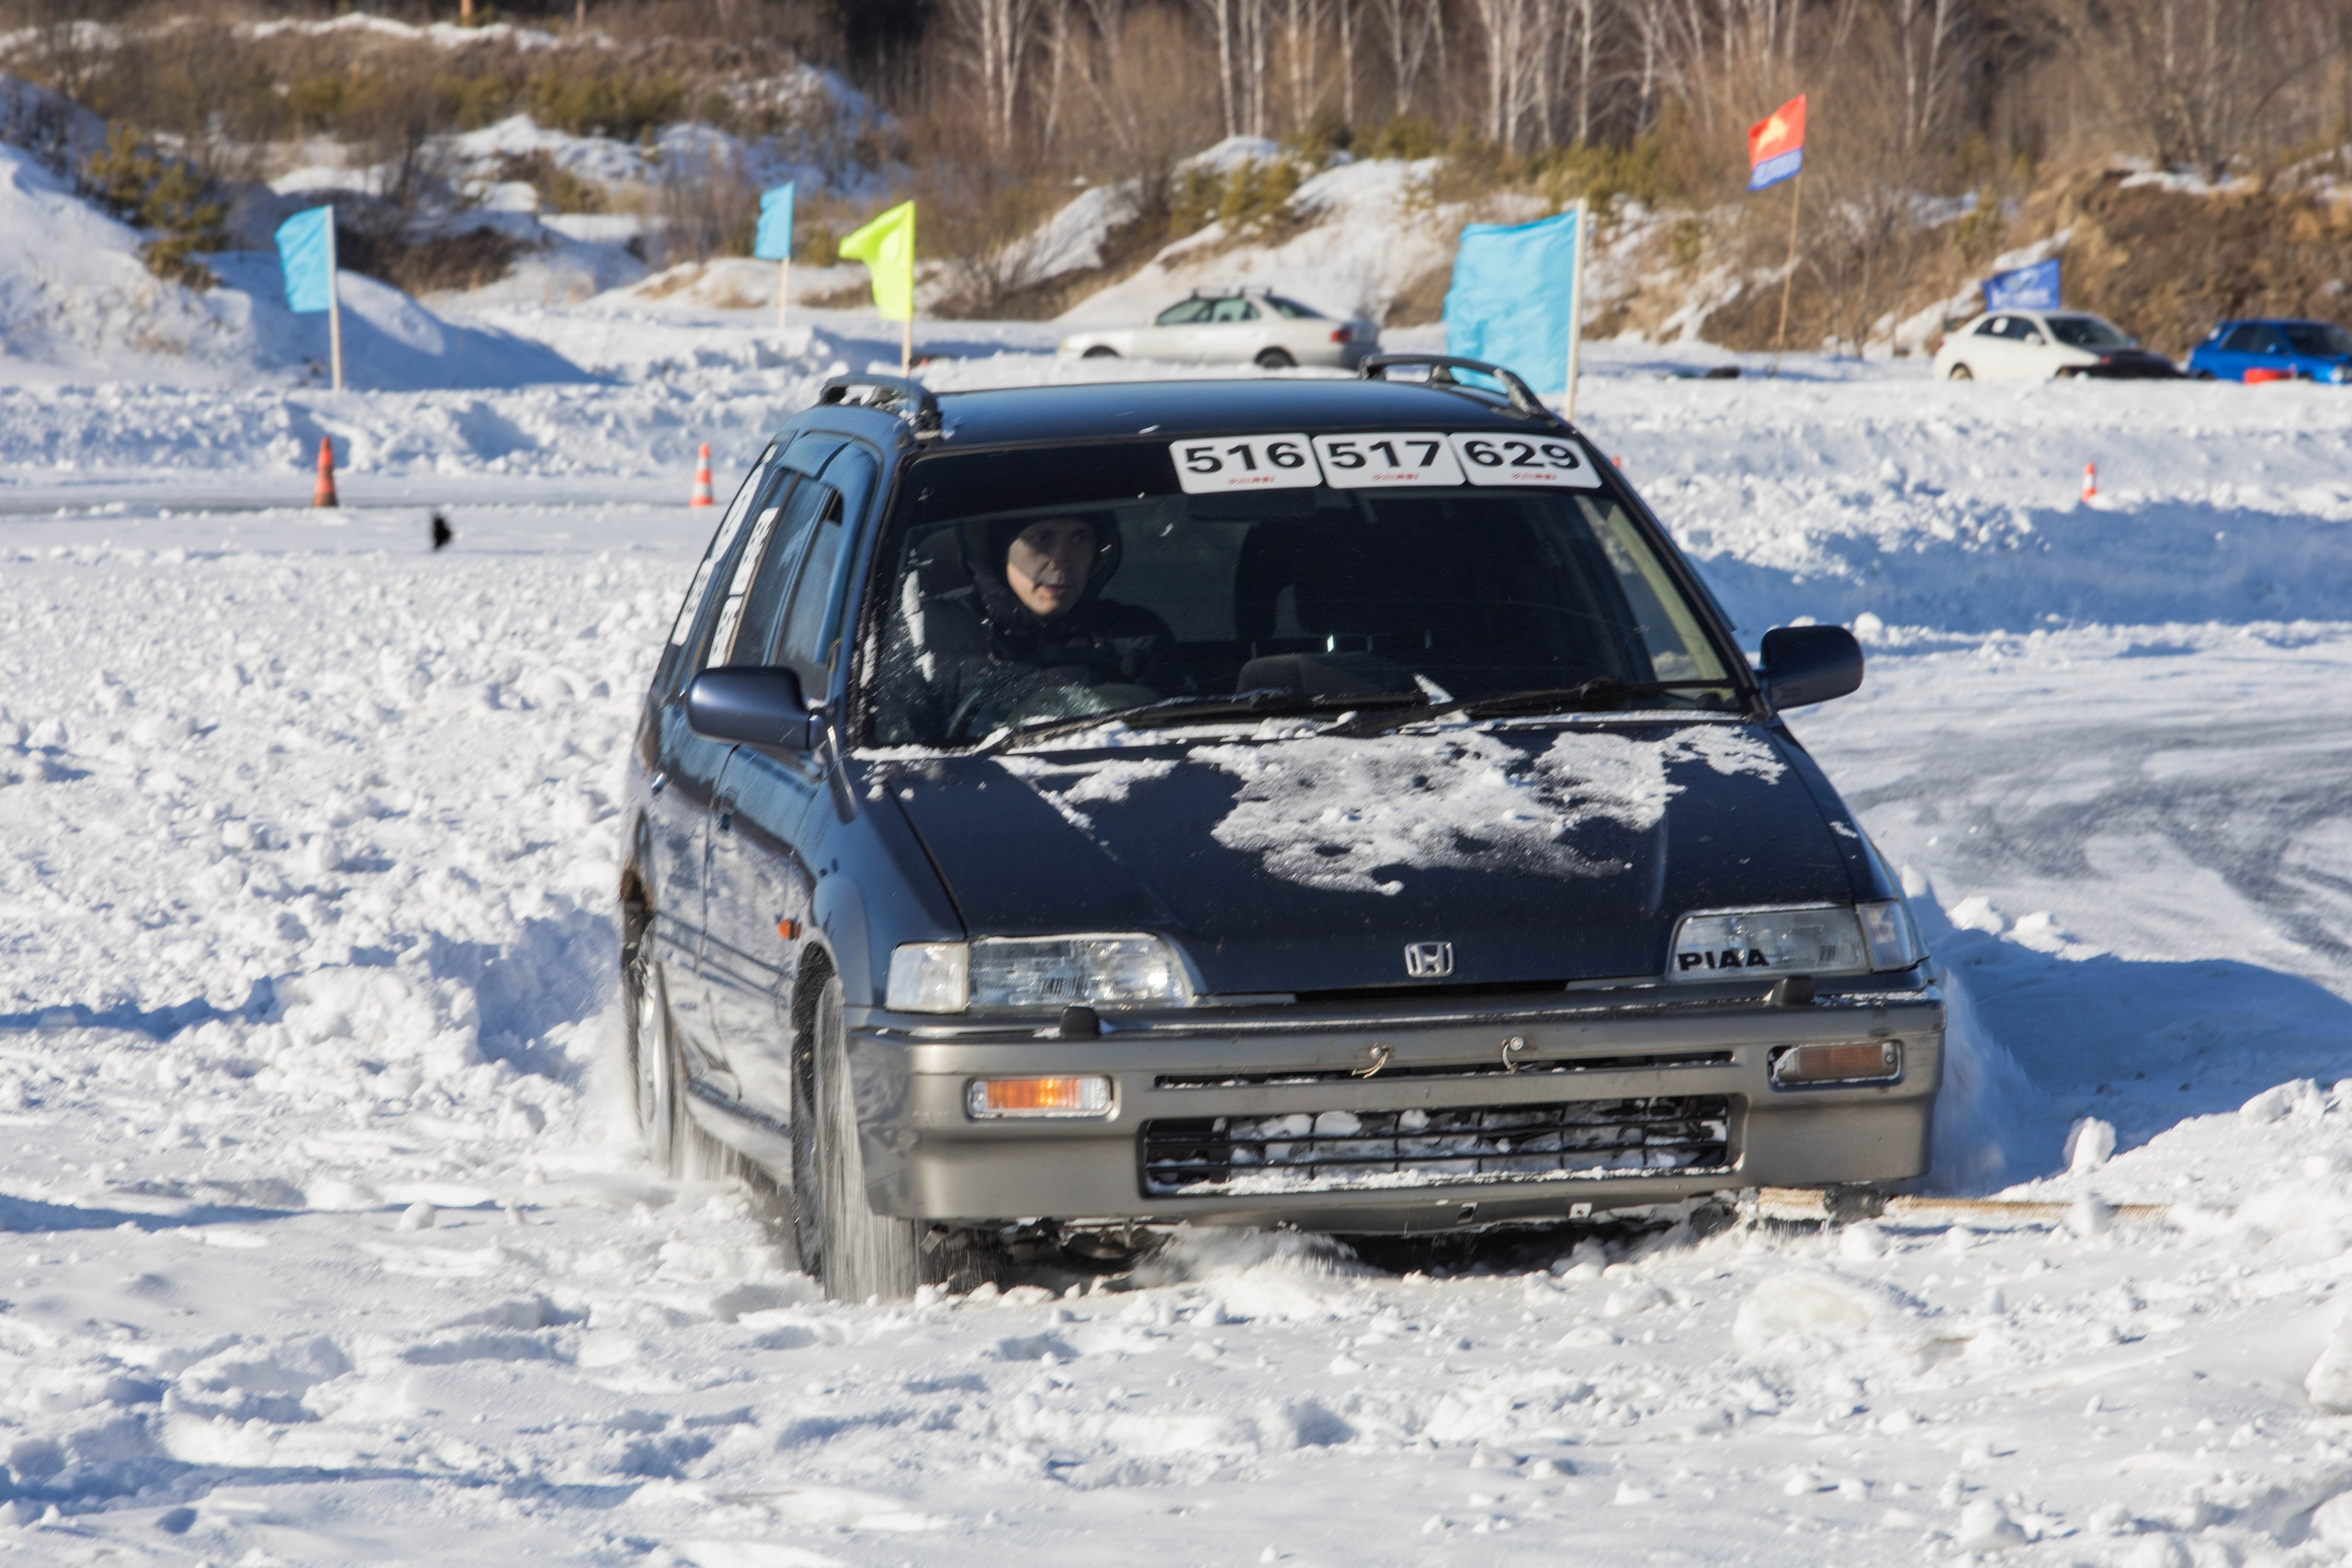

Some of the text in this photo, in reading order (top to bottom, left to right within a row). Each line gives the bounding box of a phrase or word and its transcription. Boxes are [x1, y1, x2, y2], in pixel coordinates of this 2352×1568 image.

[1185, 443, 1306, 474] 516
[1329, 440, 1442, 469] 517
[1464, 441, 1582, 470] 629
[1678, 949, 1770, 971] PIAA
